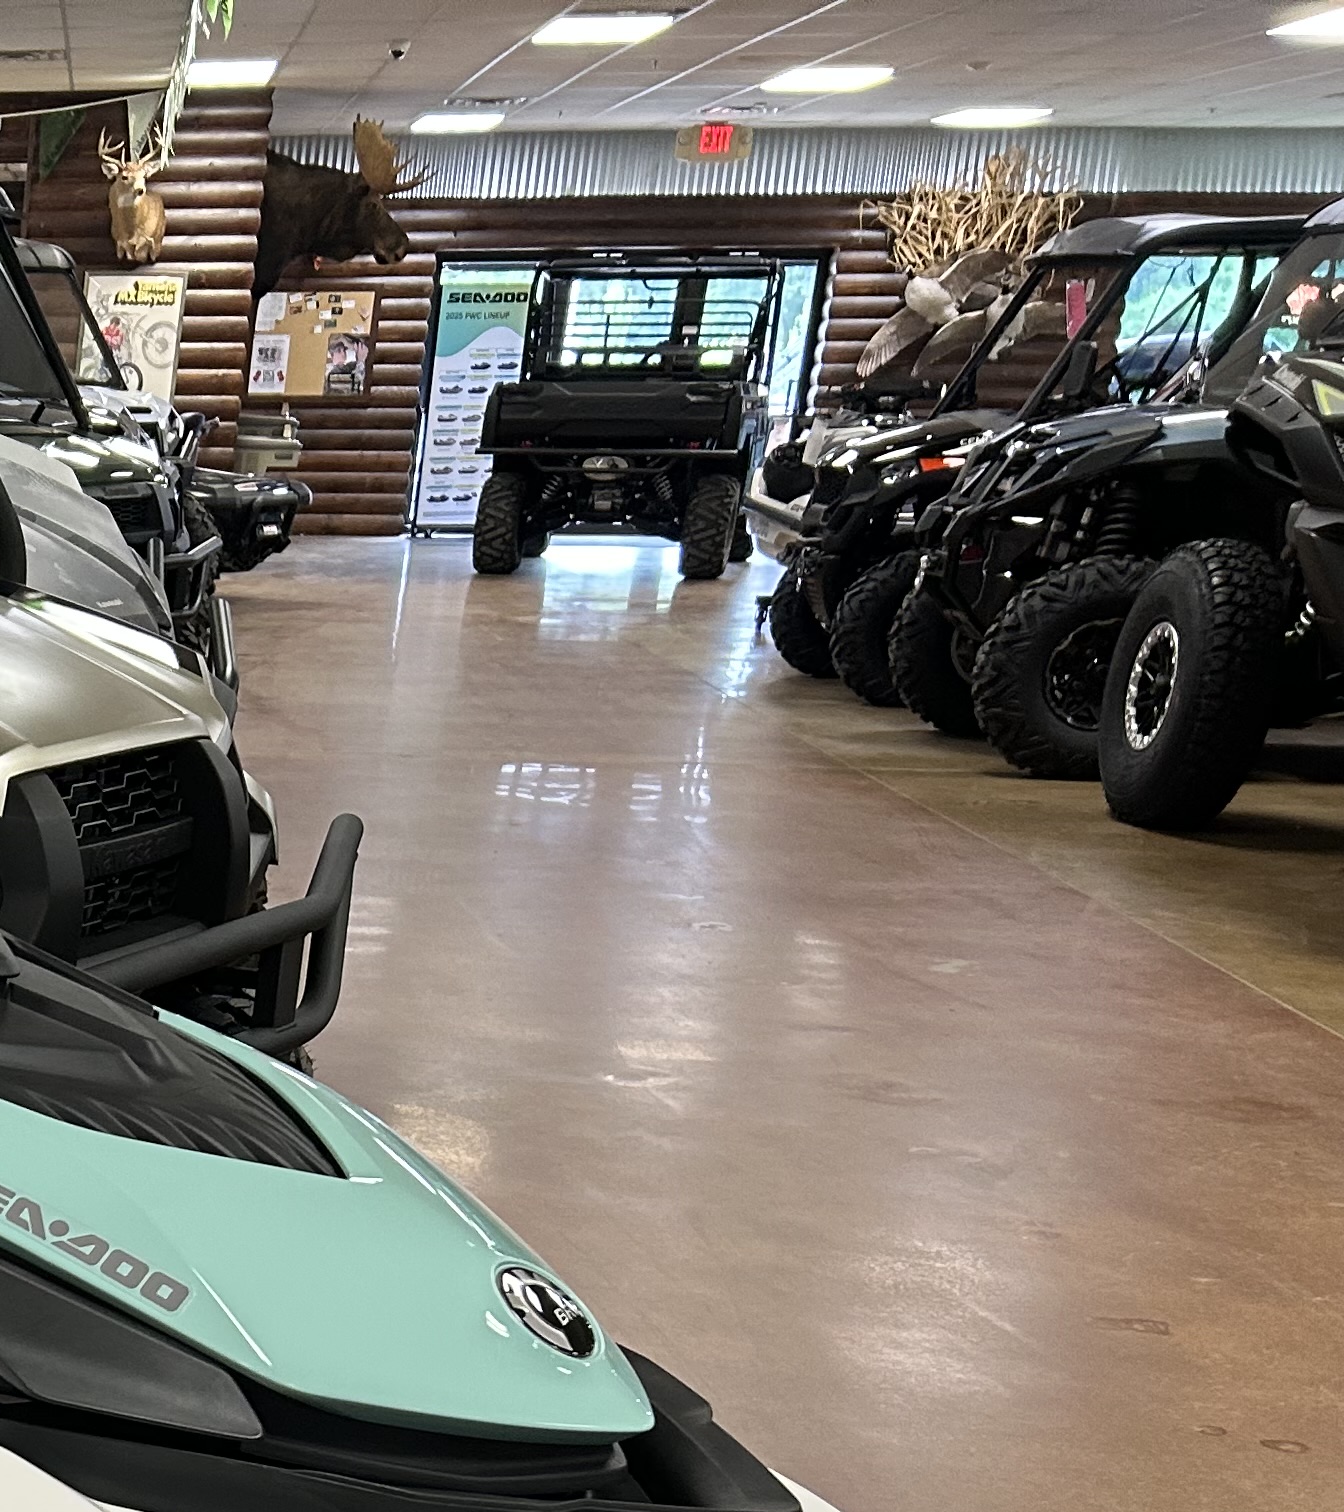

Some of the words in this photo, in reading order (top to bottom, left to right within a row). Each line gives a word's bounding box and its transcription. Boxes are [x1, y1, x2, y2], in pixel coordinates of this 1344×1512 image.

[699, 125, 733, 154] EXIT
[113, 288, 138, 305] MX
[445, 311, 464, 320] 2025
[465, 311, 482, 320] PWC
[483, 311, 510, 320] LINEUP
